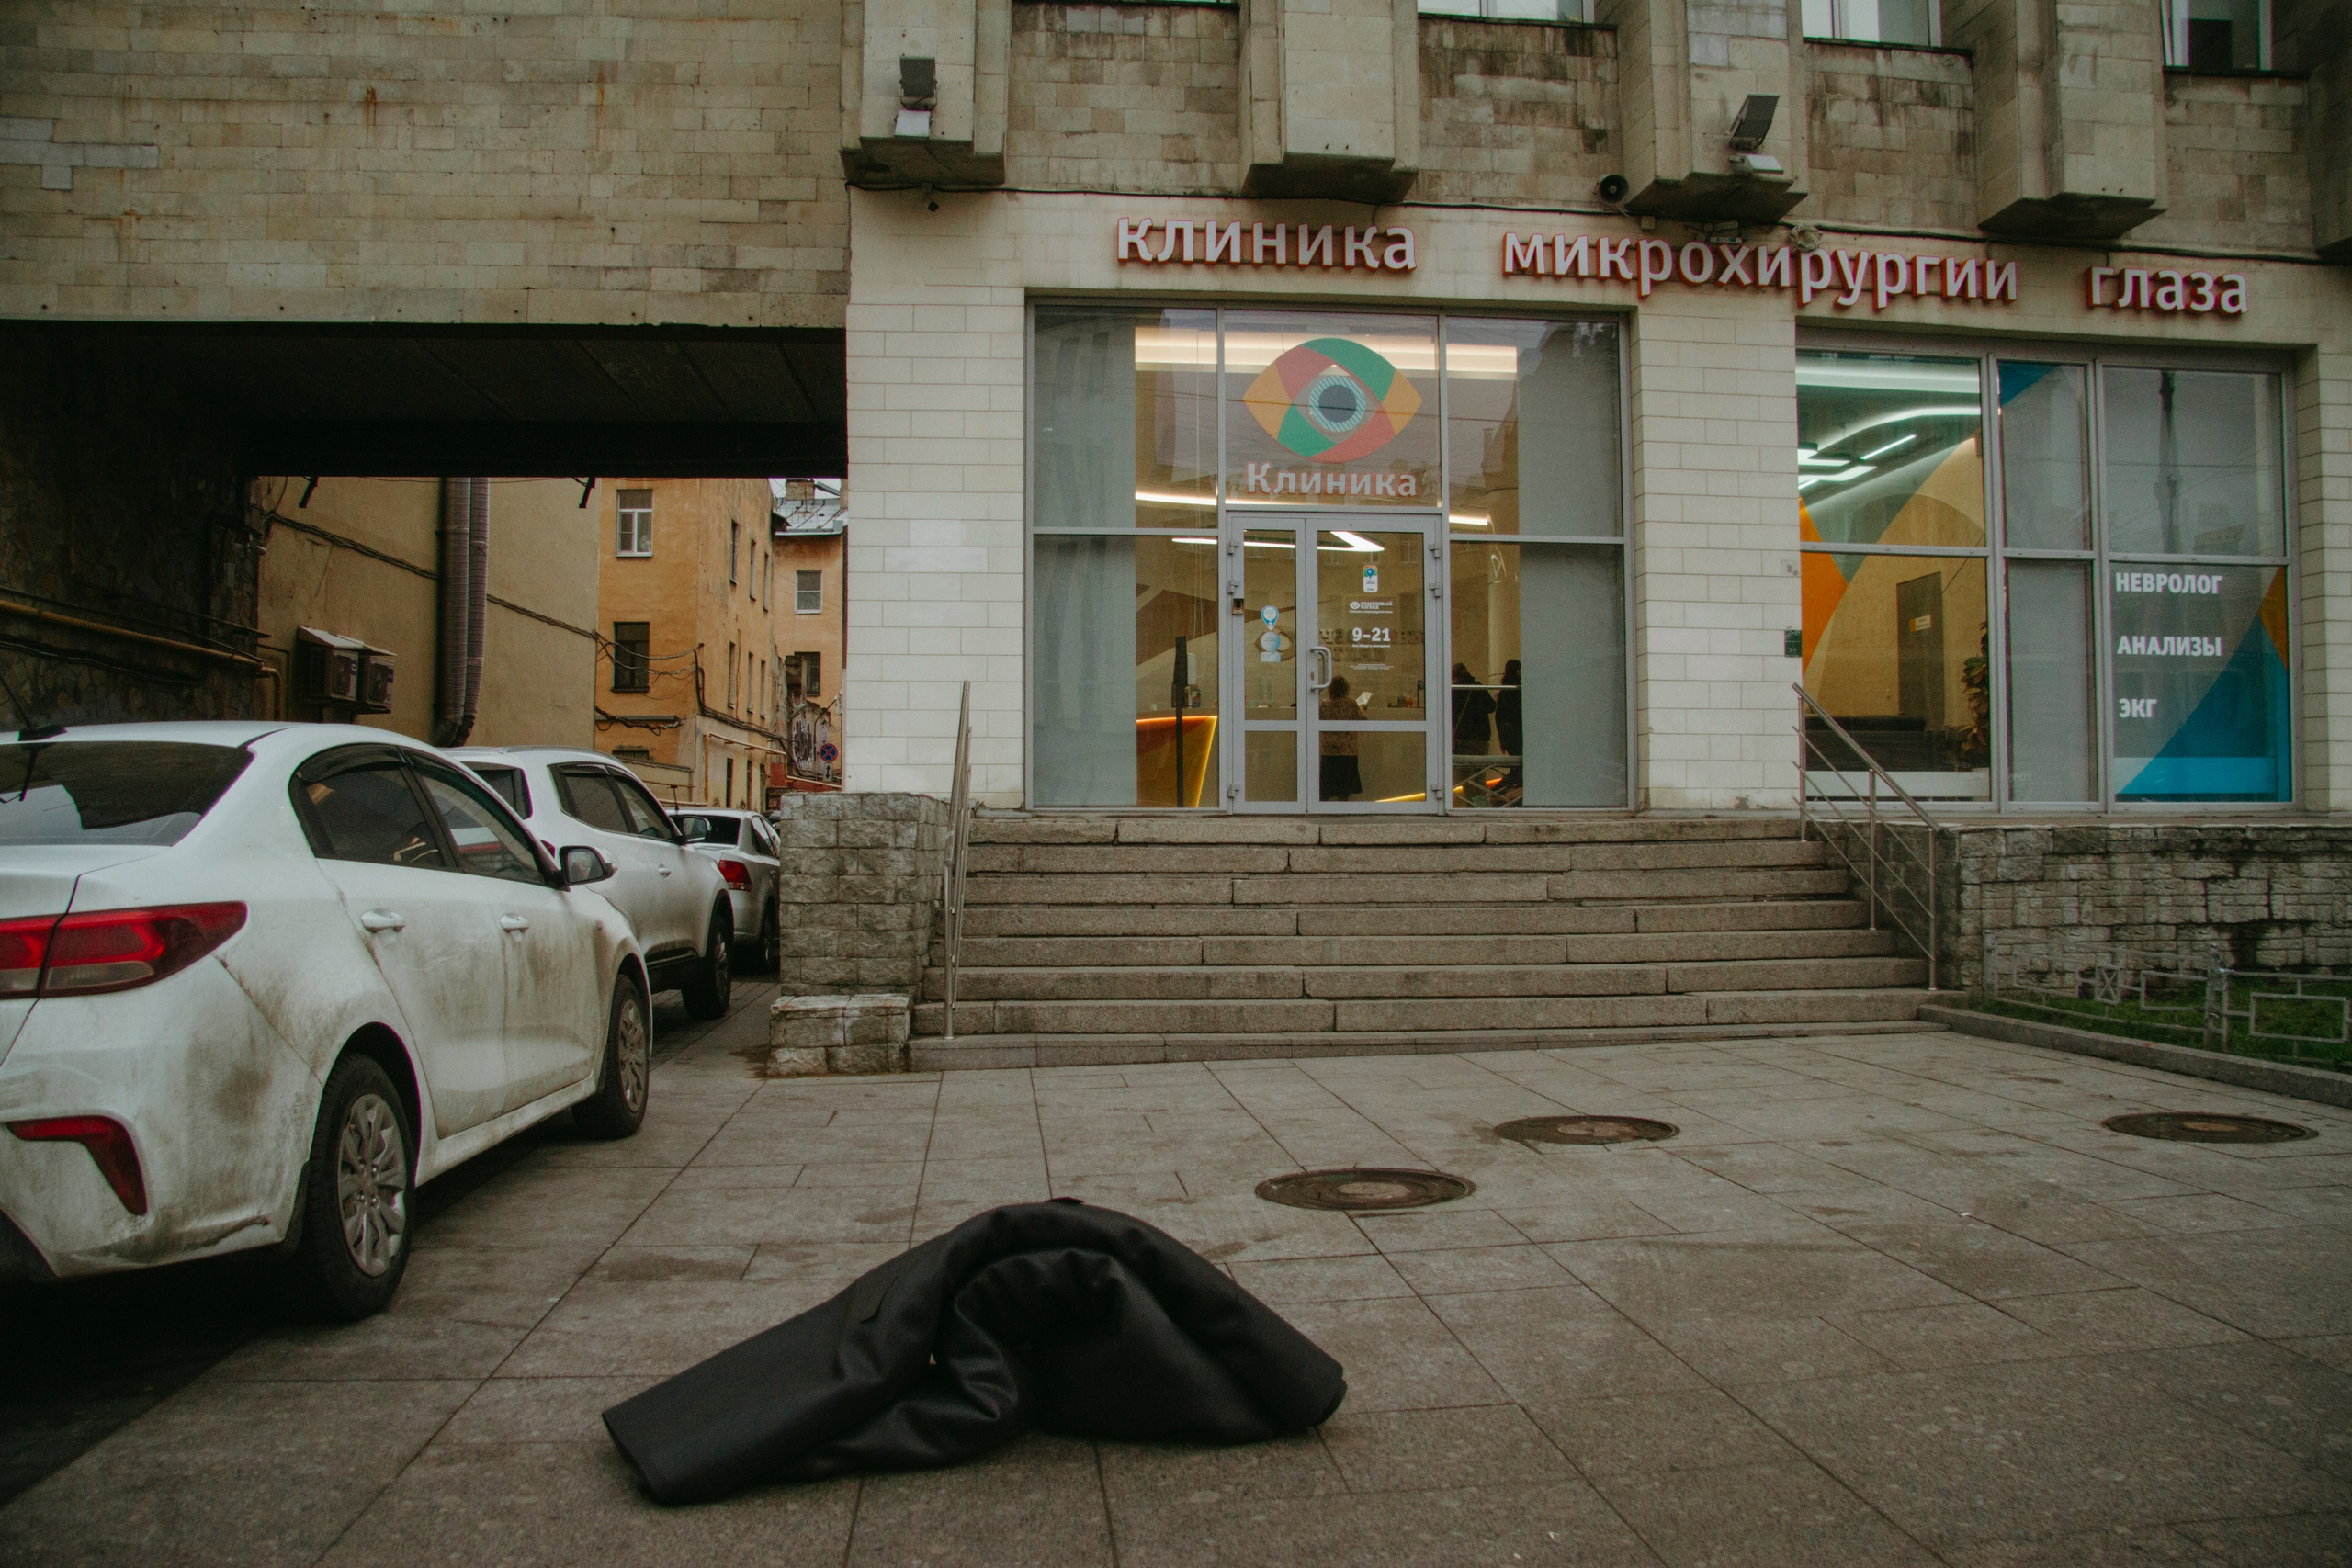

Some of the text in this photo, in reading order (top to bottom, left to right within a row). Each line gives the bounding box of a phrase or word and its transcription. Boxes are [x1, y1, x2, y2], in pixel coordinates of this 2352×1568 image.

[1116, 217, 2251, 317] клиника микрохирургии глаза
[1247, 462, 1418, 498] Клиника
[2115, 571, 2223, 595] НЕВРОЛОГ
[1351, 627, 1391, 642] 9-21
[2117, 635, 2223, 658] АНАЛИЗЫ
[2118, 698, 2158, 720] ЭКГ
